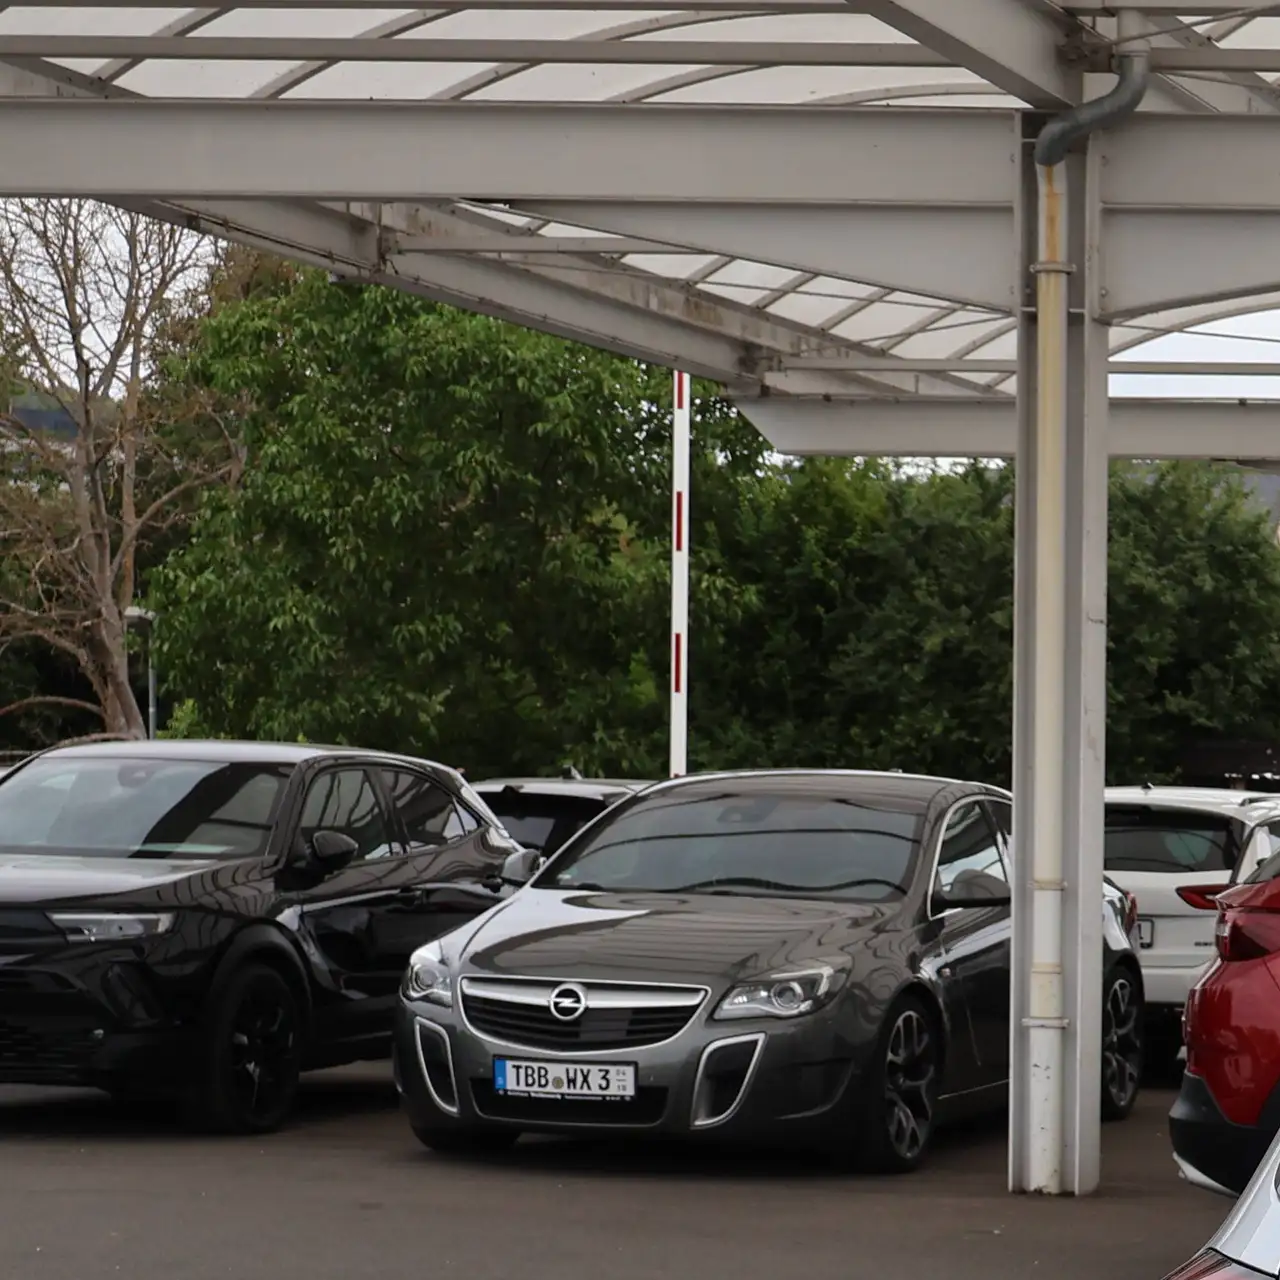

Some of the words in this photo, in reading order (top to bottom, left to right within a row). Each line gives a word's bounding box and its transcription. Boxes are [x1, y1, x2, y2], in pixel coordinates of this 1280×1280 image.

[512, 1064, 549, 1088] TBB
[566, 1067, 592, 1091] WX
[598, 1069, 610, 1091] 3
